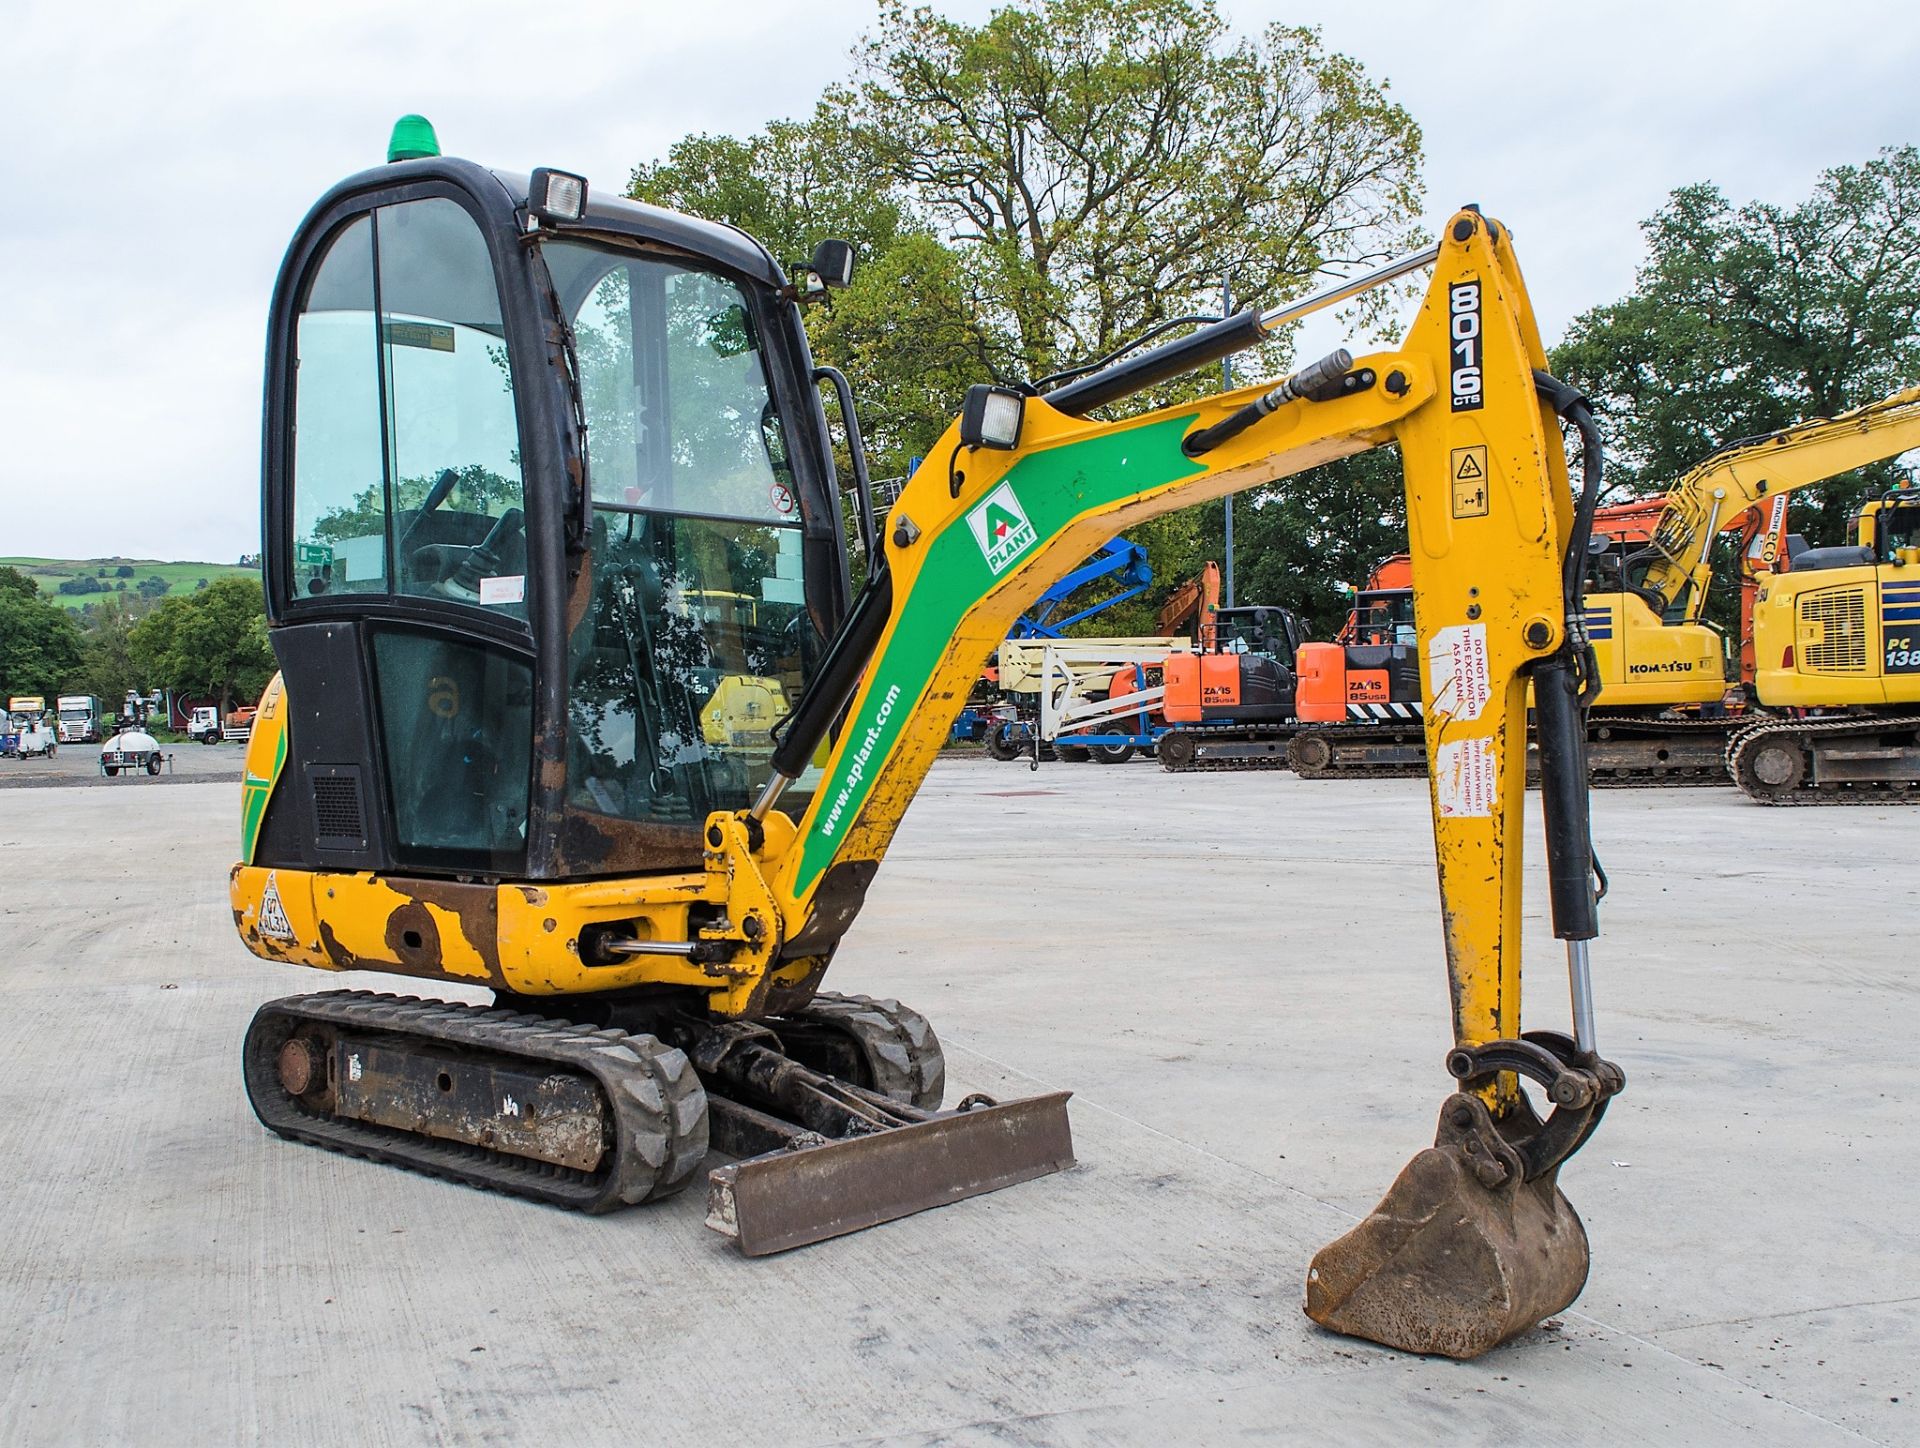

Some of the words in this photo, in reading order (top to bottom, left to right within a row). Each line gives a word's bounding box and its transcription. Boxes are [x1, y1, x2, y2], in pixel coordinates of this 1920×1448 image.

[1451, 284, 1481, 396] 8016
[1453, 393, 1481, 406] CTS
[1772, 497, 1783, 530] HITACHI
[985, 501, 1022, 551] A
[988, 525, 1032, 570] PLANT
[1763, 531, 1778, 562] eco
[1452, 642, 1461, 657] AS
[1462, 626, 1472, 652] THIS
[1474, 639, 1482, 655] DO
[1887, 637, 1910, 650] PC
[1454, 658, 1461, 666] A
[1476, 657, 1484, 680] NOT
[1629, 660, 1692, 674] KOMATSU
[1886, 650, 1920, 667] 138
[1454, 668, 1464, 702] CRANE
[1464, 654, 1476, 717] EXCAVATOR
[1477, 683, 1486, 704] USE
[821, 683, 901, 837] www.aplant.com
